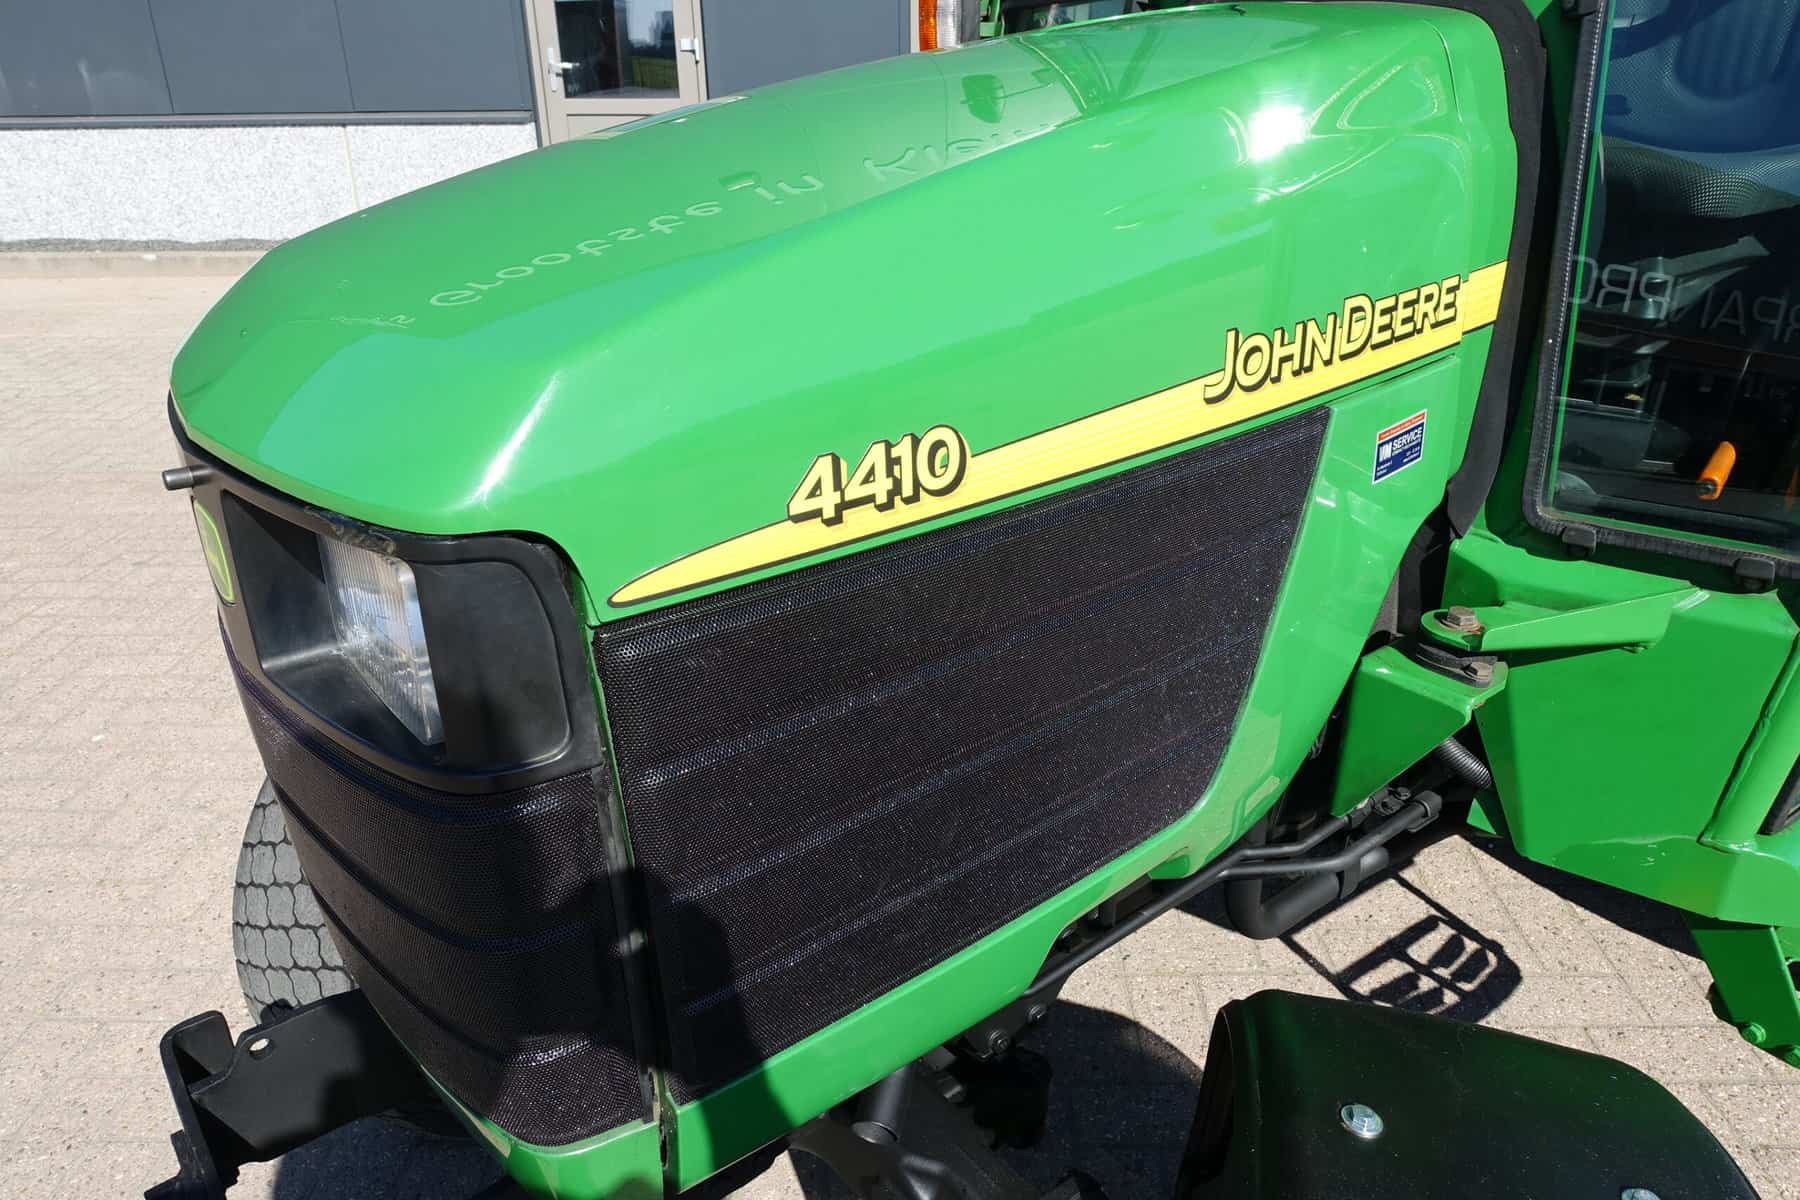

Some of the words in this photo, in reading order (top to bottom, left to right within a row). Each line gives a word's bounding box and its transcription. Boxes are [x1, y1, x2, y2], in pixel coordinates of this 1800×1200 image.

[1203, 312, 1339, 405] JOHN
[1338, 273, 1461, 361] DEERE
[786, 423, 968, 527] 4410
[1391, 426, 1424, 452] SERVICE
